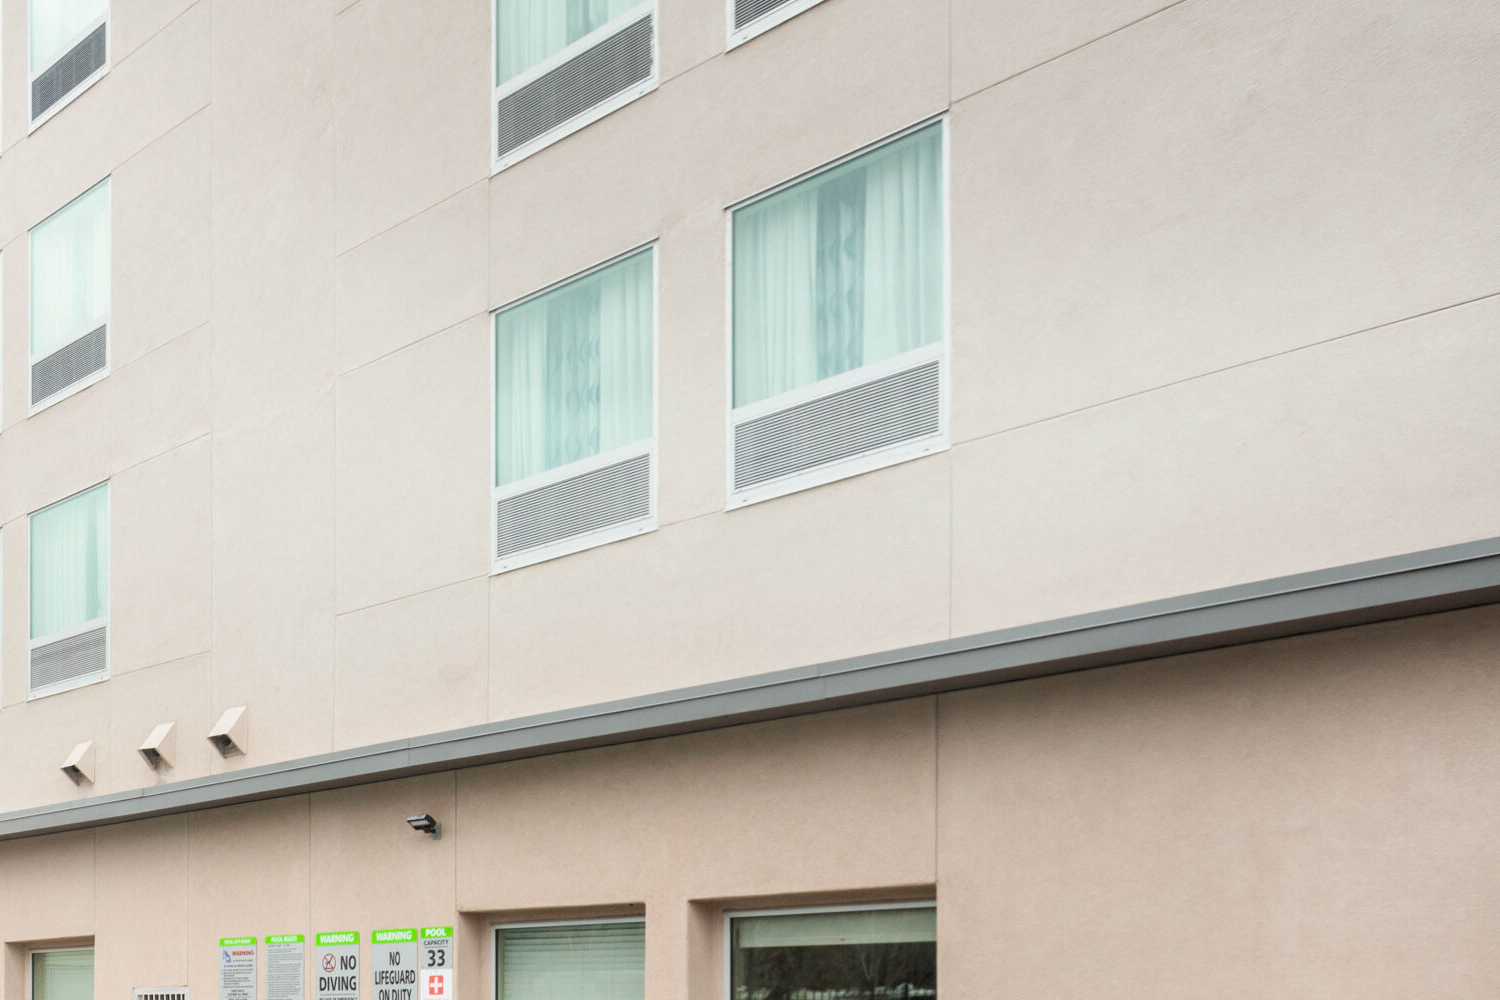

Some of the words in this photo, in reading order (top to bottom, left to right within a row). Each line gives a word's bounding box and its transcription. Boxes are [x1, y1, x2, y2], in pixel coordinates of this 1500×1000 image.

[319, 933, 355, 945] WARNING
[375, 931, 413, 942] WARNING
[425, 928, 446, 938] POOL
[340, 954, 357, 971] NO
[389, 951, 401, 966] NO
[427, 949, 446, 968] 33
[319, 976, 357, 992] DIVING
[374, 970, 416, 985] LIFEGUARD
